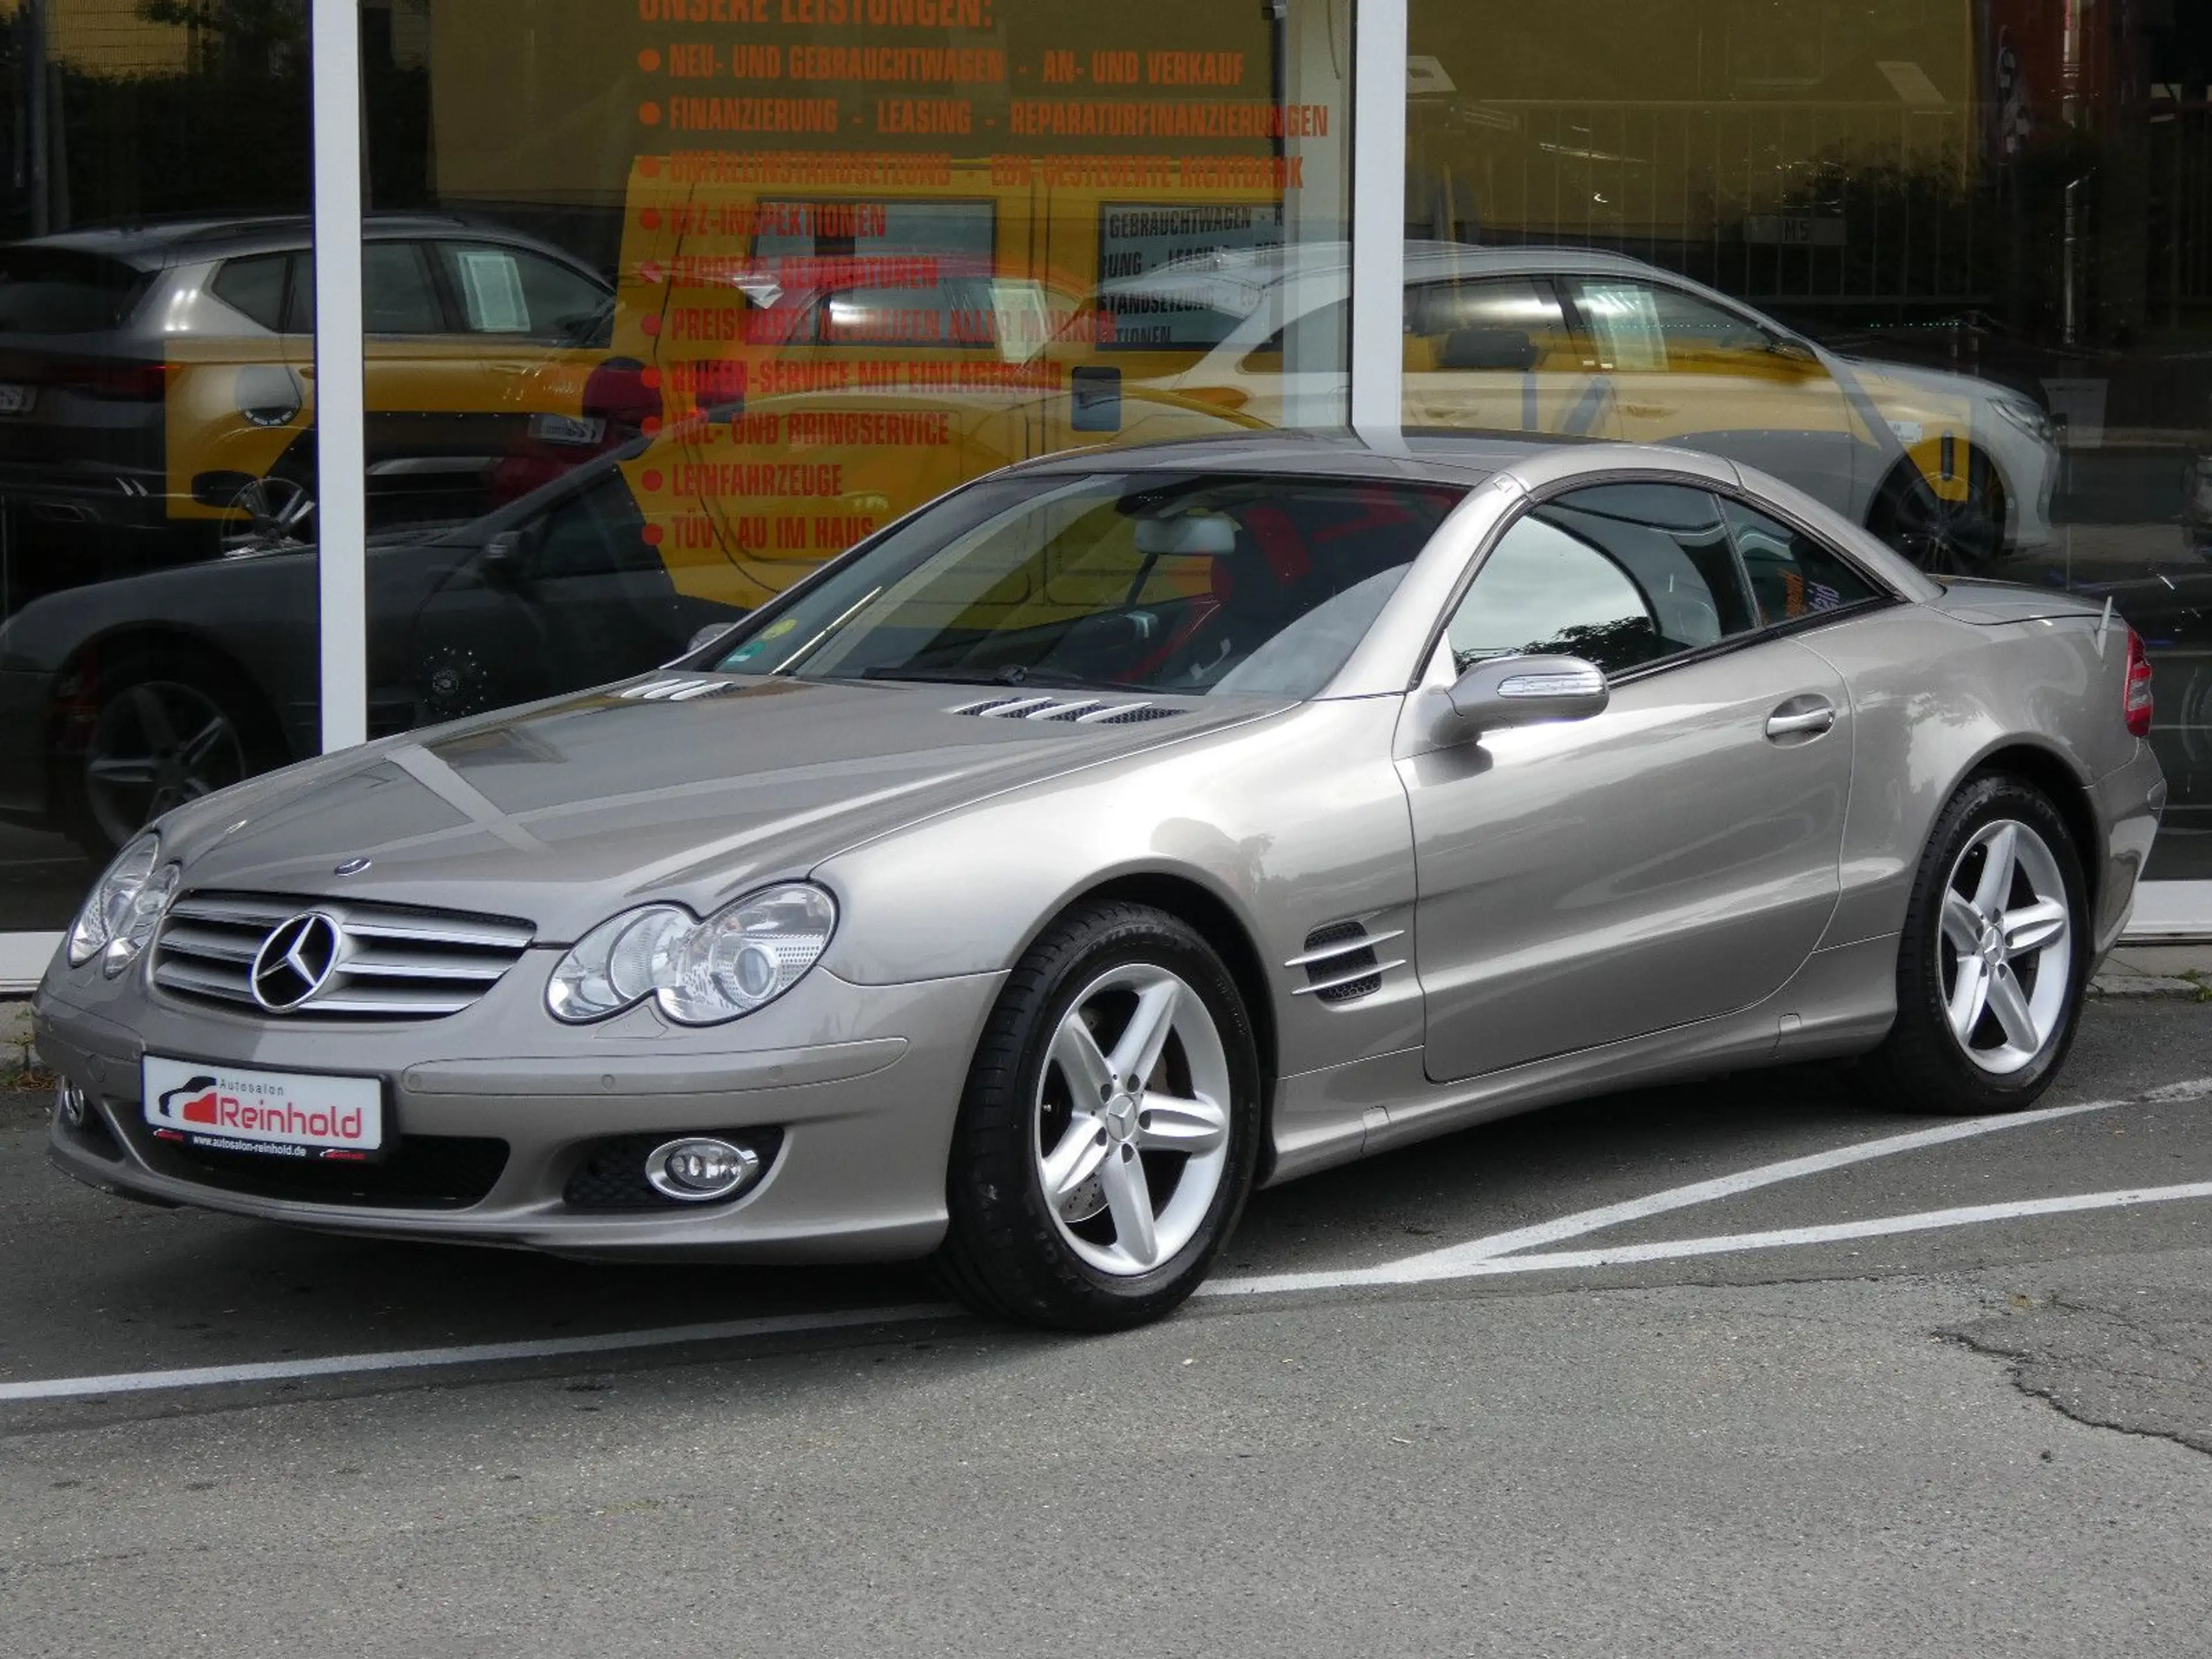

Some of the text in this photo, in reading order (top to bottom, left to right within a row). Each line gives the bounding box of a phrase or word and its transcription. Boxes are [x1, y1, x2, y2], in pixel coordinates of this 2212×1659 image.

[669, 44, 724, 77] NEU-
[733, 45, 781, 79] UND
[789, 46, 1003, 84] GEBRAUCHTWAGEN
[1043, 50, 1084, 84] AN-
[1094, 51, 1139, 85] UND
[1147, 52, 1244, 85] VERKAUF
[669, 97, 838, 132] FINANZIERUNG
[877, 100, 972, 134] LEASING
[1010, 103, 1328, 137] REPARATURFINANZIERUNGEN
[1180, 156, 1303, 189] RICHTBANK
[671, 202, 887, 238] KFZ-INSPEKTIONEN
[1109, 206, 1252, 239] GEBRAUCHTWAGEN
[781, 256, 940, 289] REPARATUREN
[672, 359, 1062, 395] REIFEN-SERVICE MIT EINLAGERUNG
[672, 411, 949, 445] HOL- UND BRINGSERVICE
[672, 464, 842, 497] LEIHFAHRZEUGE
[672, 507, 714, 549] TÜV
[738, 517, 767, 549] AU
[776, 517, 806, 549] IM
[814, 517, 874, 549] HAUS
[219, 1078, 285, 1096] Autosalon
[220, 1097, 362, 1139] Reinhold
[193, 1135, 307, 1158] www.autosalon-reinhold.de
